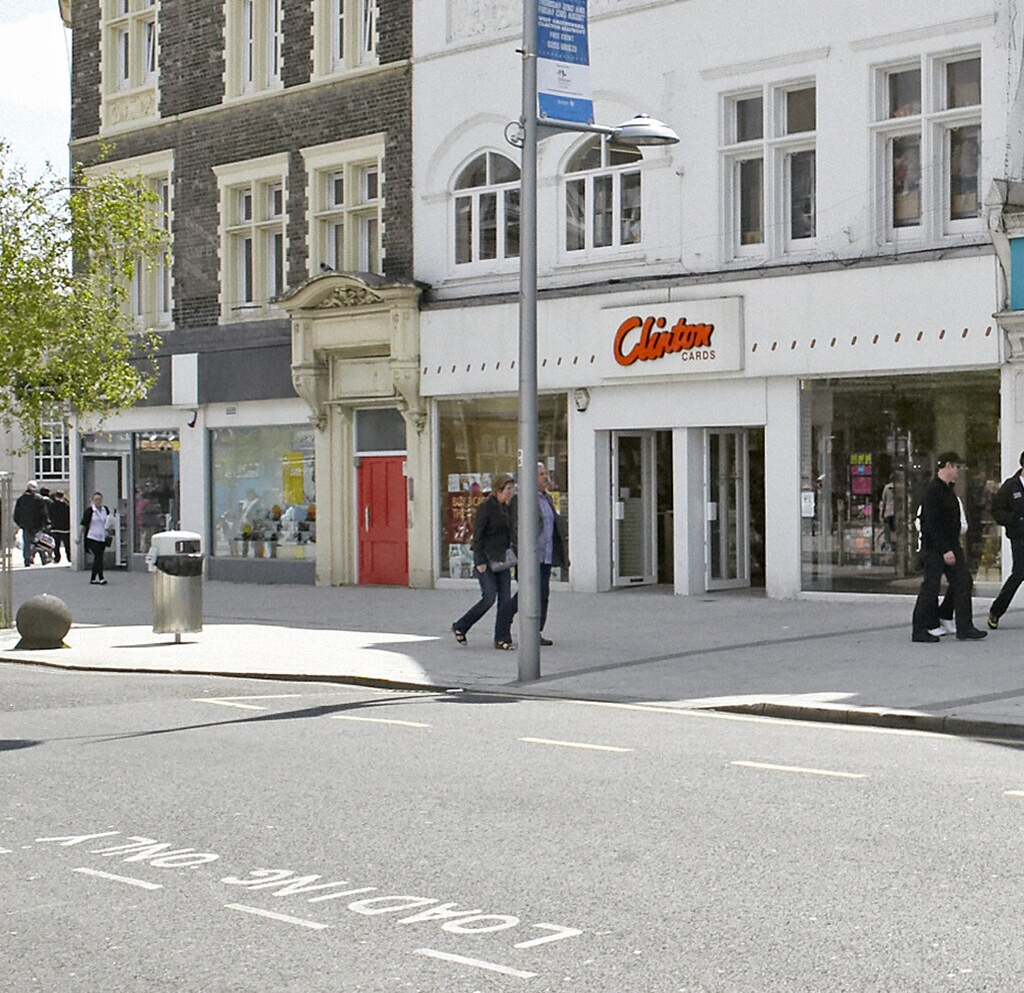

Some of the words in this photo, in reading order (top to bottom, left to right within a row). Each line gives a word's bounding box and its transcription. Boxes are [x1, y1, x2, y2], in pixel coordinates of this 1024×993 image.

[613, 316, 714, 367] Clinton
[681, 350, 716, 362] CARDS
[35, 831, 220, 870] ONLY
[220, 867, 584, 949] LOADING
